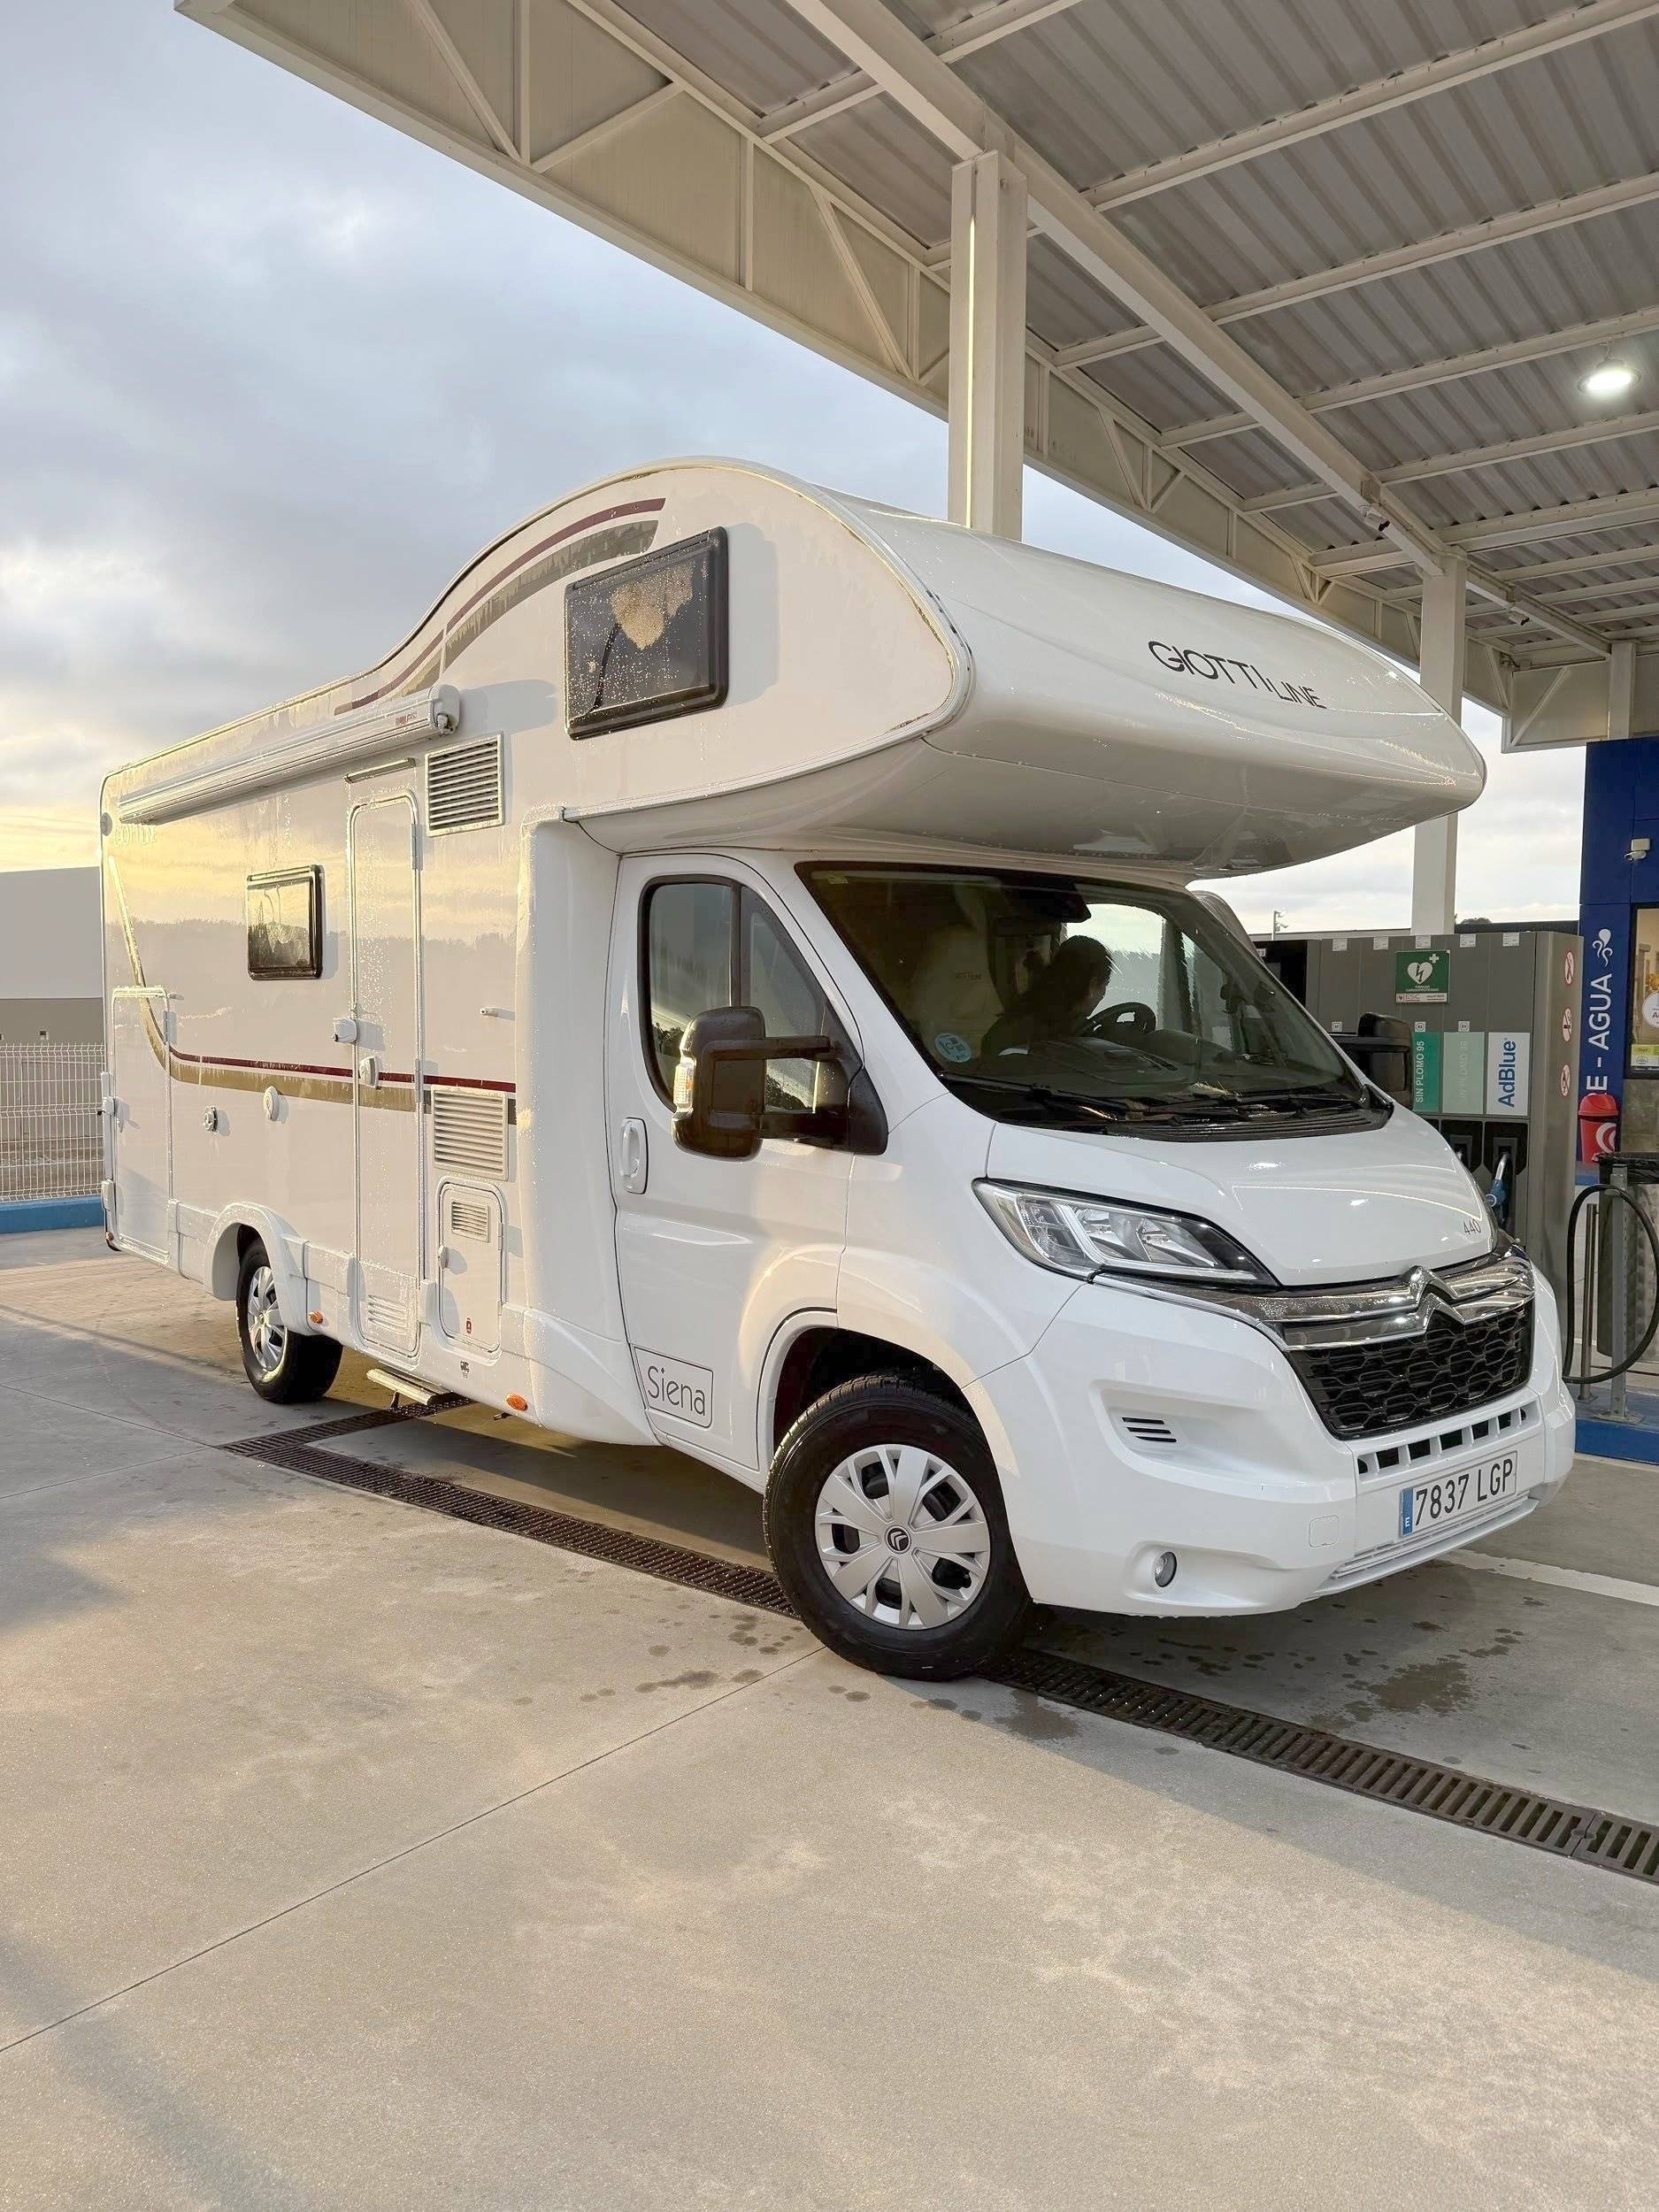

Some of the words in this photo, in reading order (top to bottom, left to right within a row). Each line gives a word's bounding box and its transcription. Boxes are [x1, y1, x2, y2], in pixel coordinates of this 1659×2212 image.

[1588, 973, 1612, 1051] AGUA
[1416, 1040, 1425, 1052] 95
[1416, 1053, 1425, 1087] PLOMO
[1498, 1041, 1517, 1108] AdBlue
[1463, 1218, 1482, 1235] 440
[647, 1365, 706, 1417] Siena
[1405, 1516, 1410, 1527] E
[1415, 1473, 1470, 1526] 7837
[1477, 1458, 1513, 1502] LGP
